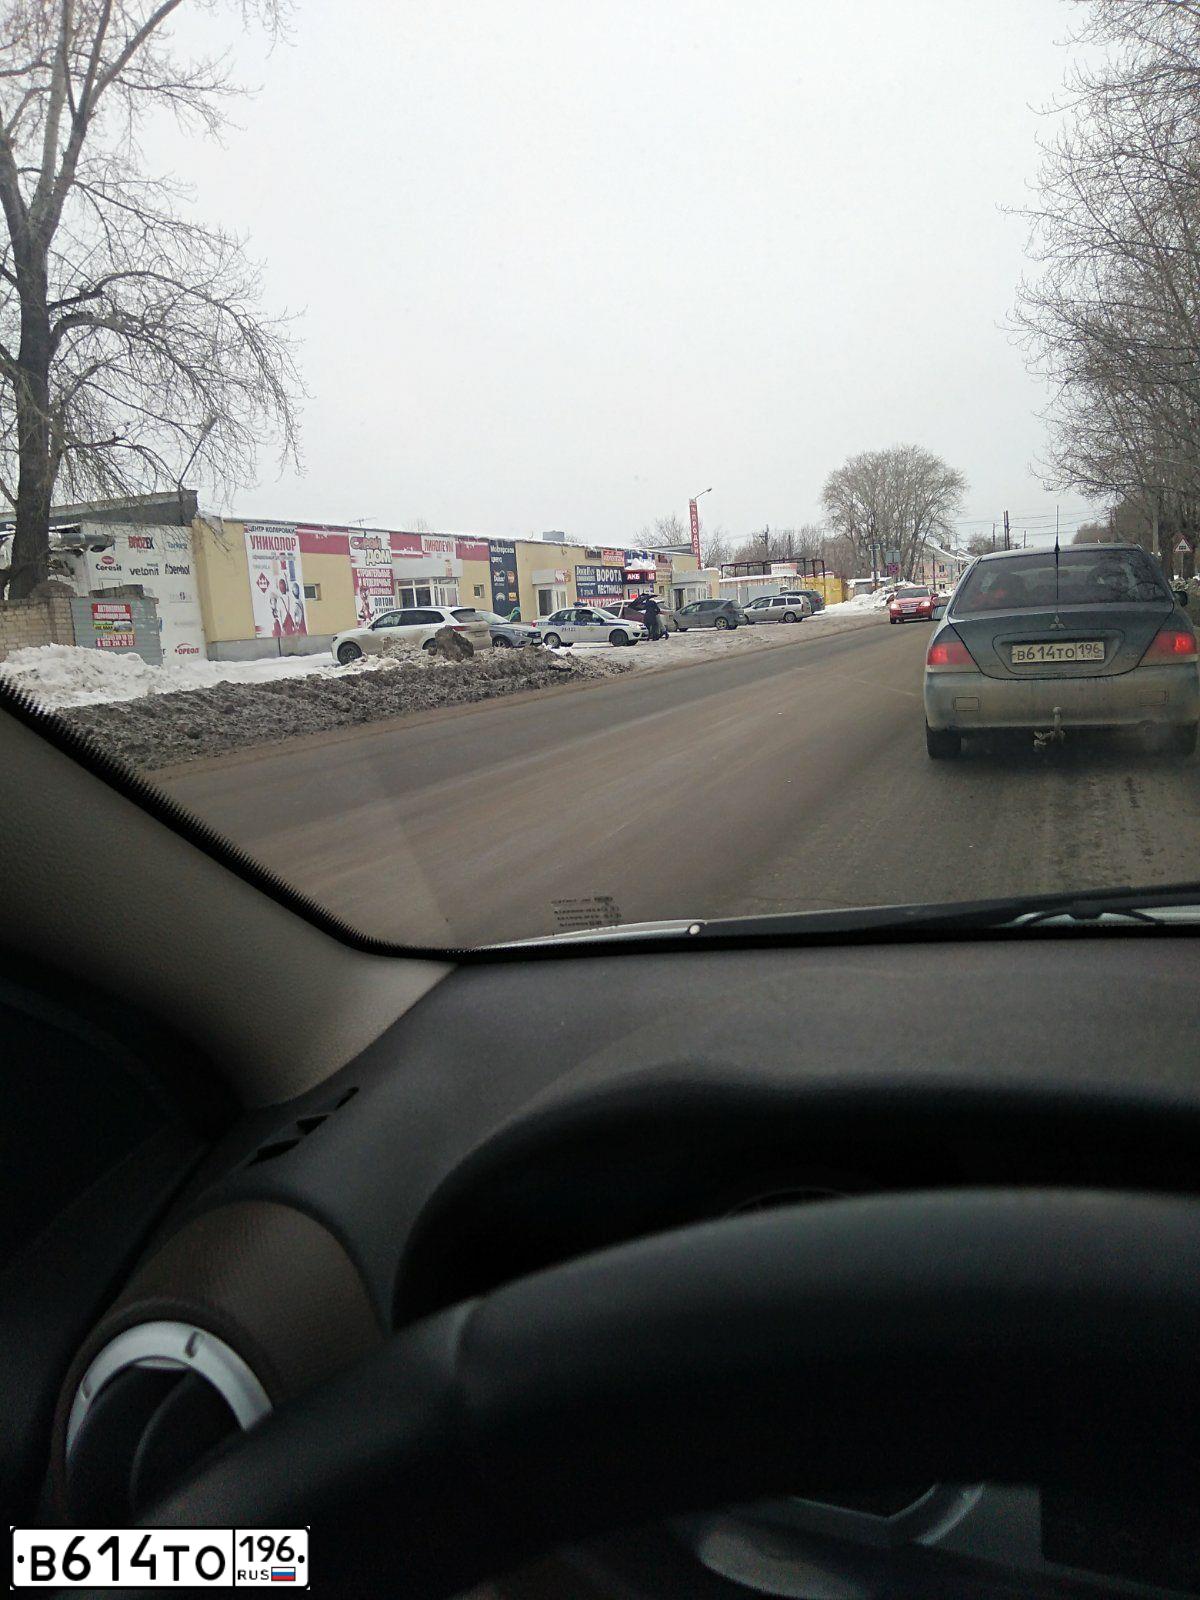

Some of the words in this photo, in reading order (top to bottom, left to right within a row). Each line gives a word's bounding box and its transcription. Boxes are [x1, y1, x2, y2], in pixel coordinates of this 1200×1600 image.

[250, 535, 296, 551] УНИКОЛОР
[366, 549, 392, 566] ДОМ
[596, 568, 623, 582] ВОРОТА
[597, 584, 623, 595] ЛЕСТНИЦЫ
[1017, 645, 1075, 661] В614ТО
[1078, 643, 1102, 655] 196
